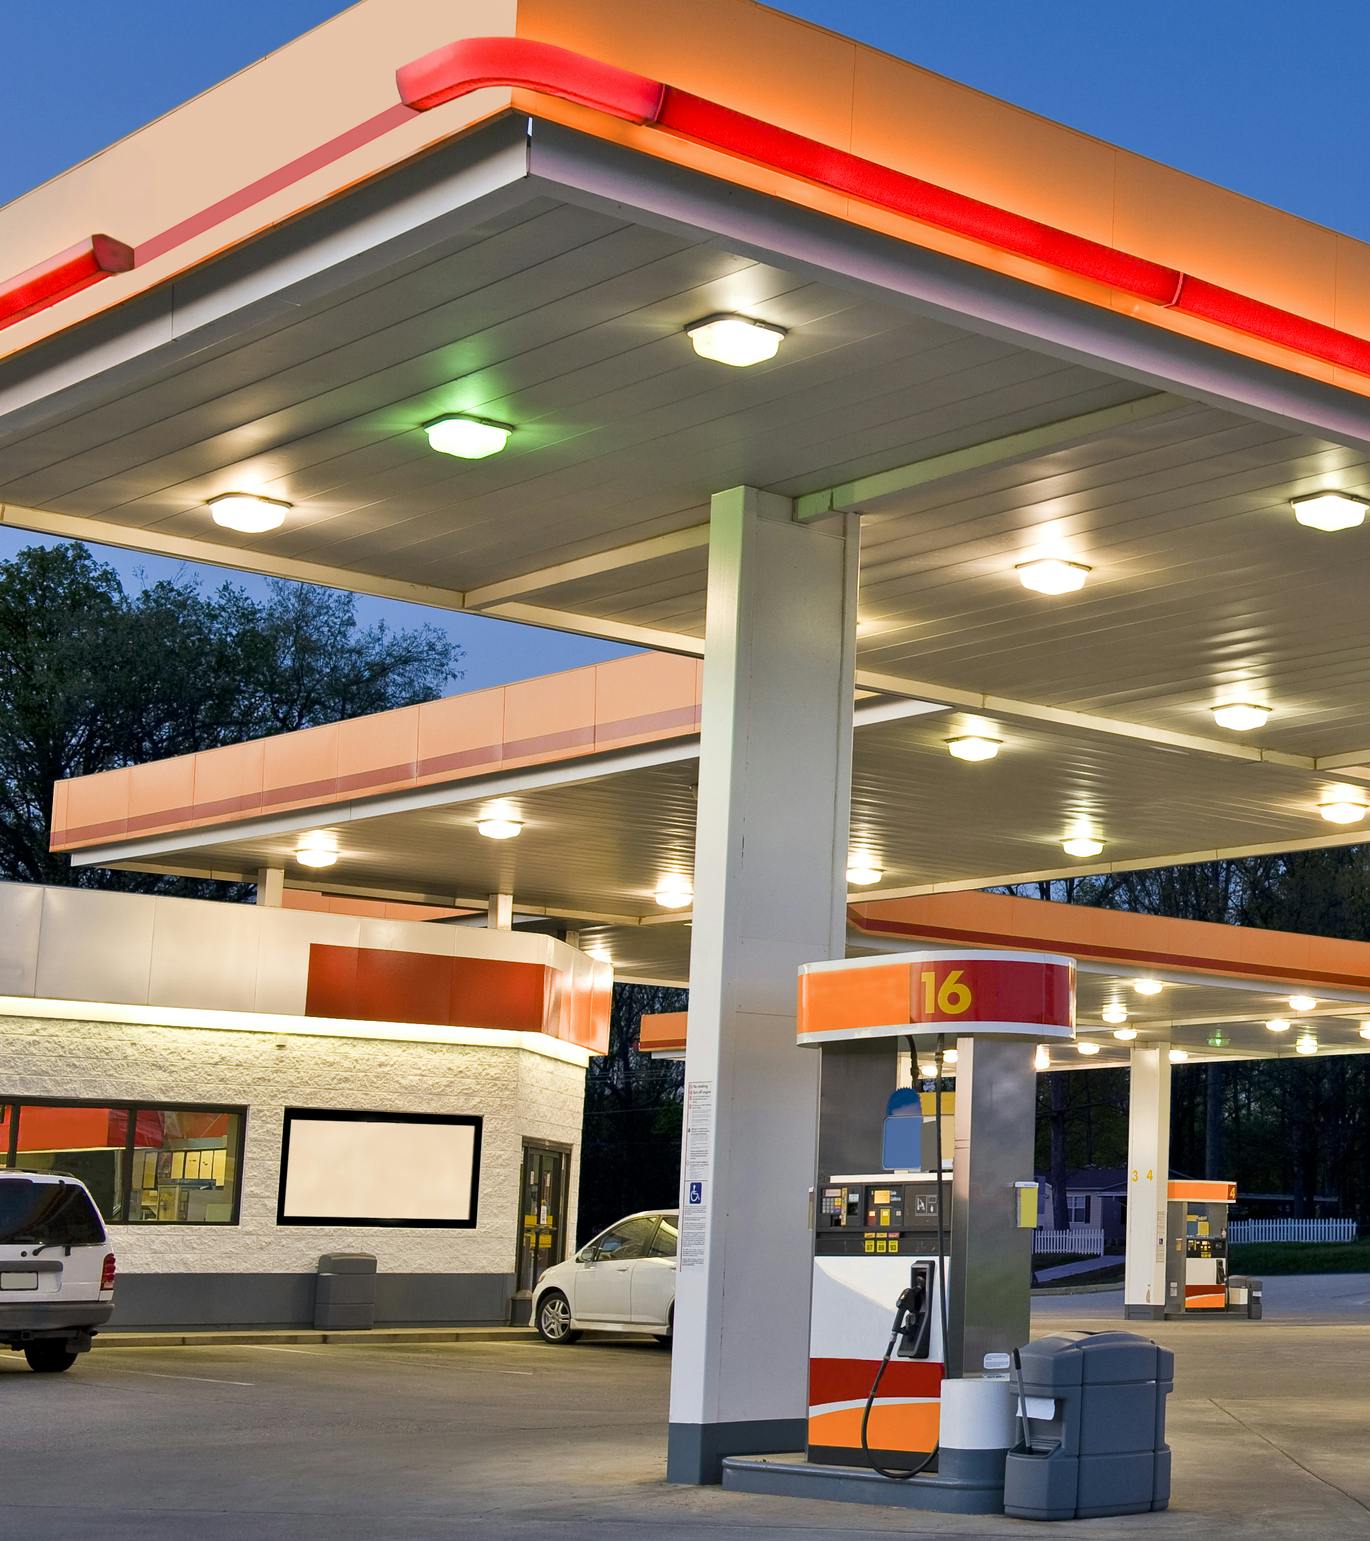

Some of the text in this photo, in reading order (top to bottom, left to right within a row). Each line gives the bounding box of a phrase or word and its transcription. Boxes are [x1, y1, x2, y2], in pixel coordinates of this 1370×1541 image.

[921, 970, 972, 1015] 16
[1131, 1169, 1153, 1182] 3 4
[1229, 1187, 1236, 1199] 4
